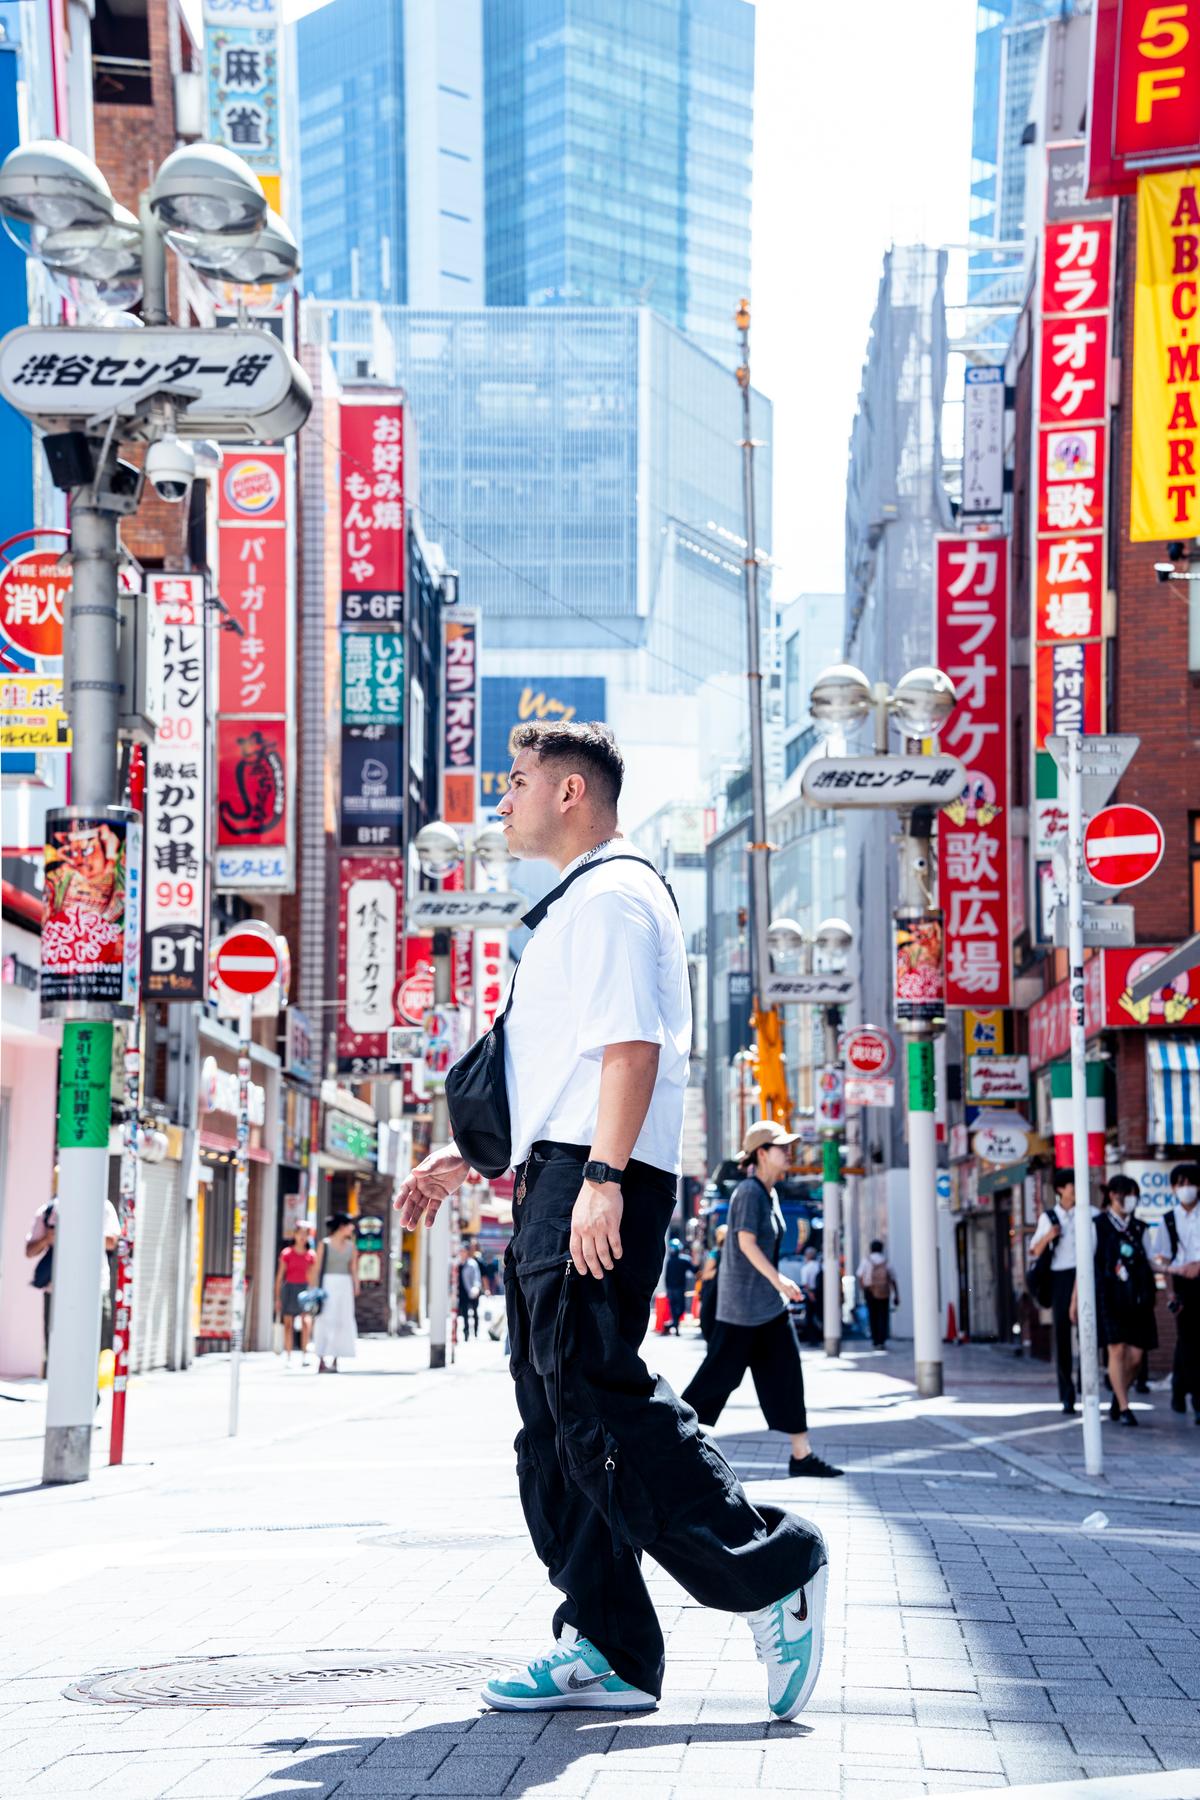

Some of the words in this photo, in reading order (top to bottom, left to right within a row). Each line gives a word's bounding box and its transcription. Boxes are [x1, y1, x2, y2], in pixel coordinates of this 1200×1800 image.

[225, 49, 262, 145] 麻雀
[1136, 4, 1190, 124] 5F
[13, 353, 273, 388] 渋谷センター街
[372, 415, 402, 531] お好み焼
[344, 472, 375, 584] もんじゃ
[5, 582, 73, 625] 消火
[240, 537, 267, 708] バーガーキング
[178, 628, 201, 709] レモン
[345, 635, 373, 713] 無呼吸
[375, 635, 404, 713] いびき
[813, 768, 956, 788] 渋谷センター街
[154, 784, 196, 875] かわ串
[357, 826, 391, 845] B1F
[156, 881, 194, 908] 99
[416, 901, 519, 915] 渋谷センター街
[150, 936, 197, 973] B1
[1141, 1172, 1168, 1188] COI
